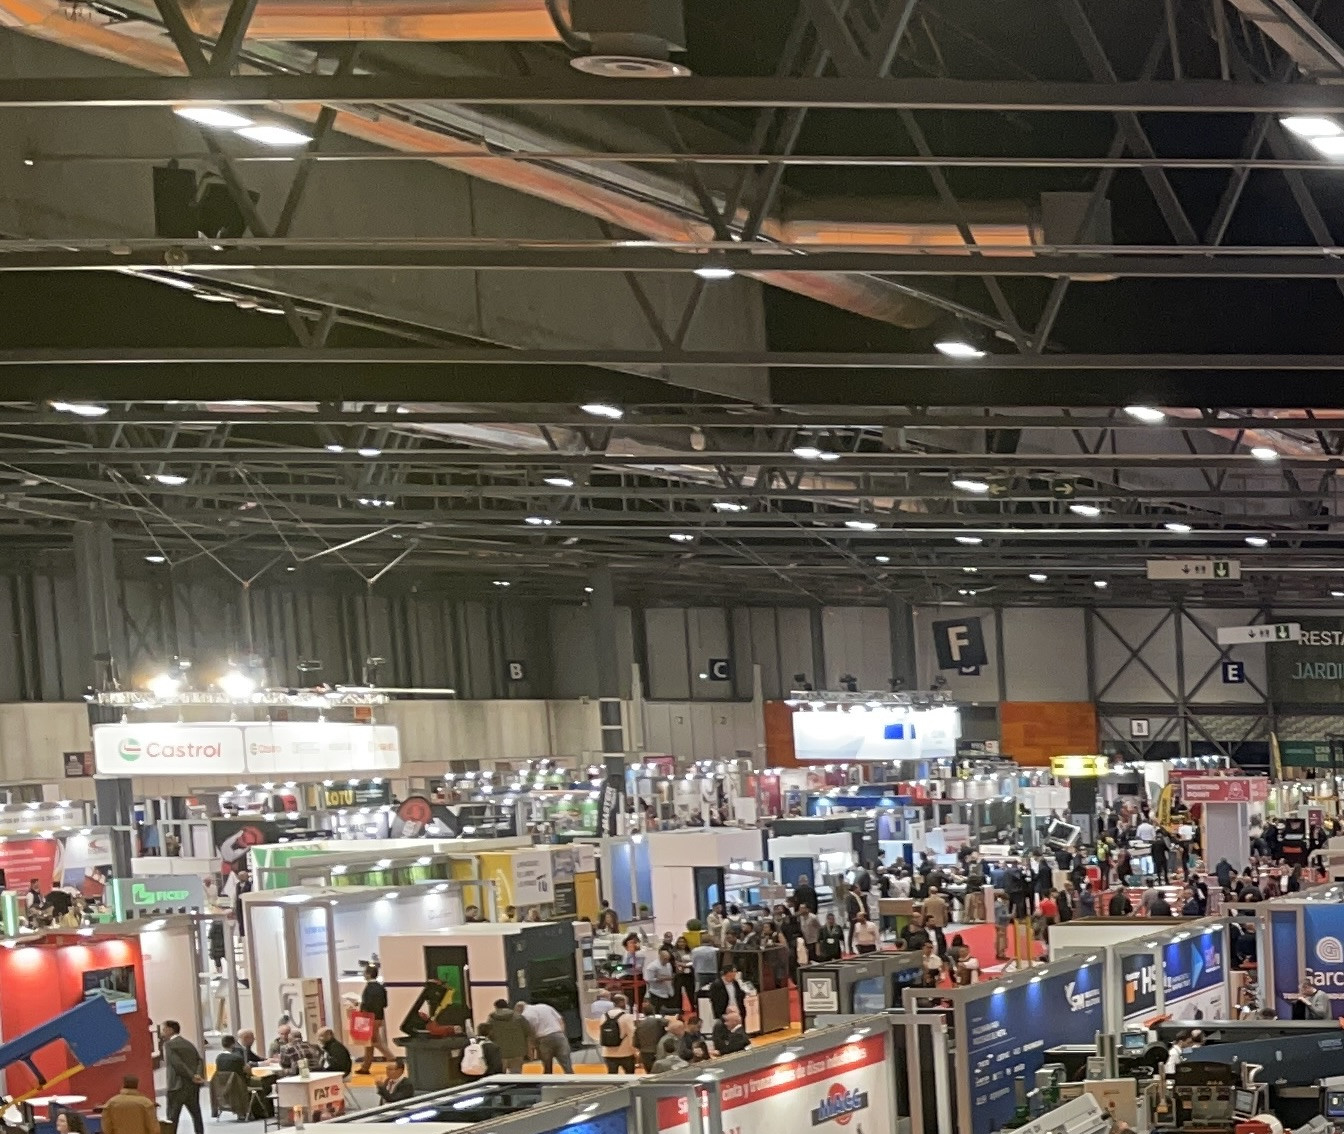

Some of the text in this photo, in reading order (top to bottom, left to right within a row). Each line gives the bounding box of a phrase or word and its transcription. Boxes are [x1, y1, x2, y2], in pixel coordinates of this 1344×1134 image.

[947, 625, 970, 661] F
[511, 663, 523, 680] B
[714, 661, 727, 677] C
[1228, 664, 1240, 681] E
[146, 742, 222, 758] Castrol
